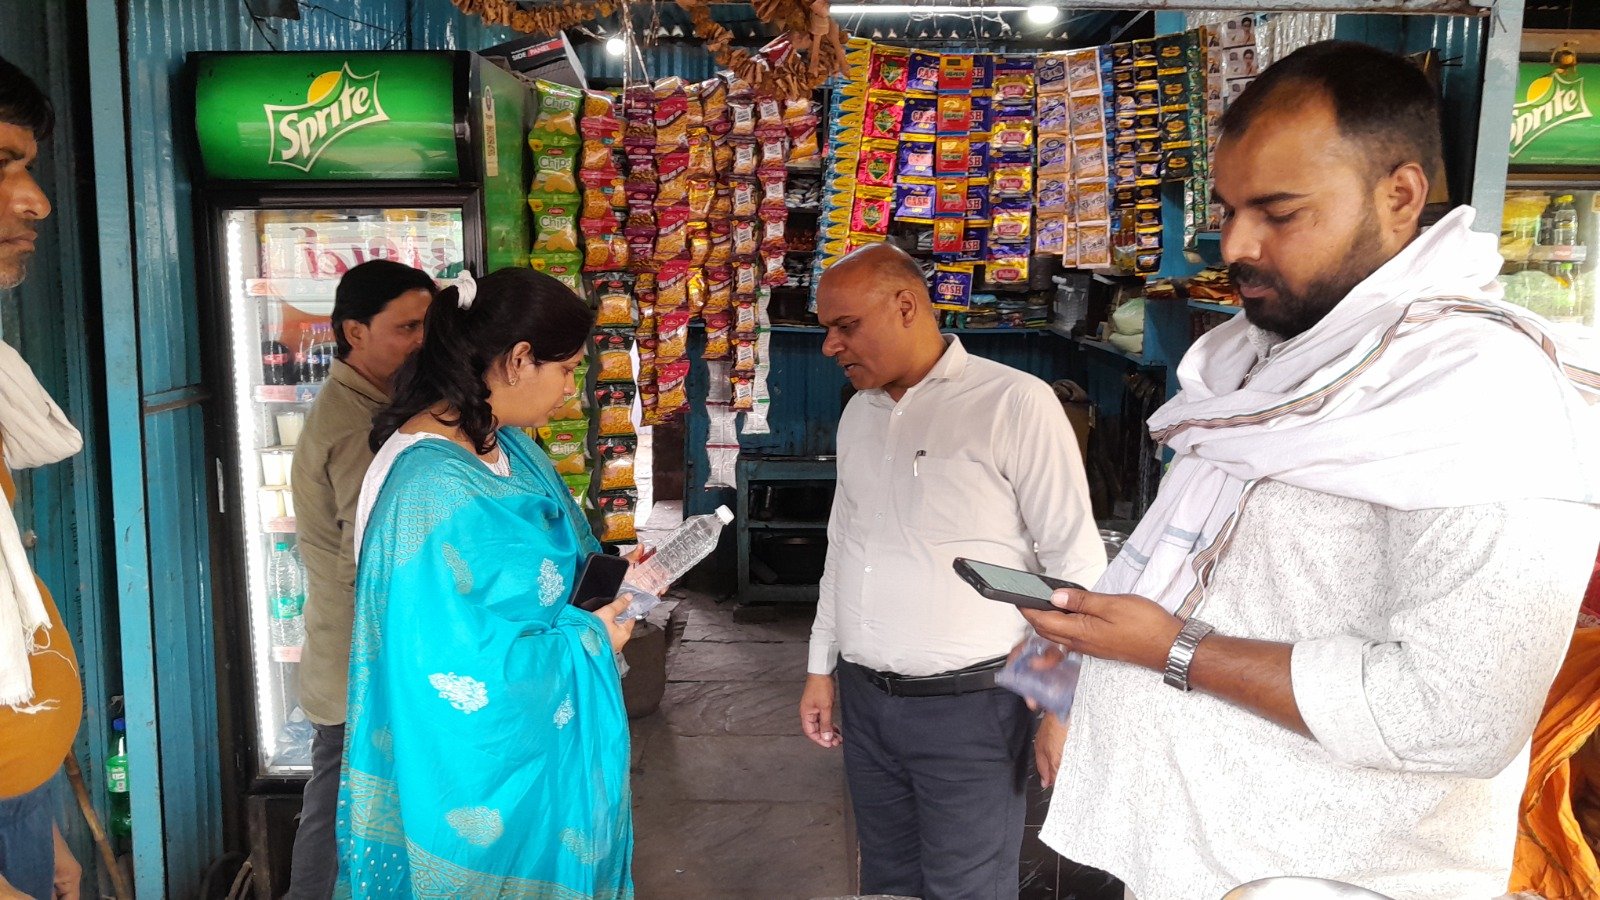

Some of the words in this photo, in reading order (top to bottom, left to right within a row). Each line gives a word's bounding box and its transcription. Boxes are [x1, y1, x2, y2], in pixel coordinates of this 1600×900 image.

[511, 52, 527, 61] SIDE
[544, 97, 576, 110] Chips
[279, 79, 371, 161] Sprite
[538, 155, 572, 170] Chips
[539, 215, 574, 230] Chips
[962, 240, 980, 250] ASH
[938, 282, 963, 296] CASH
